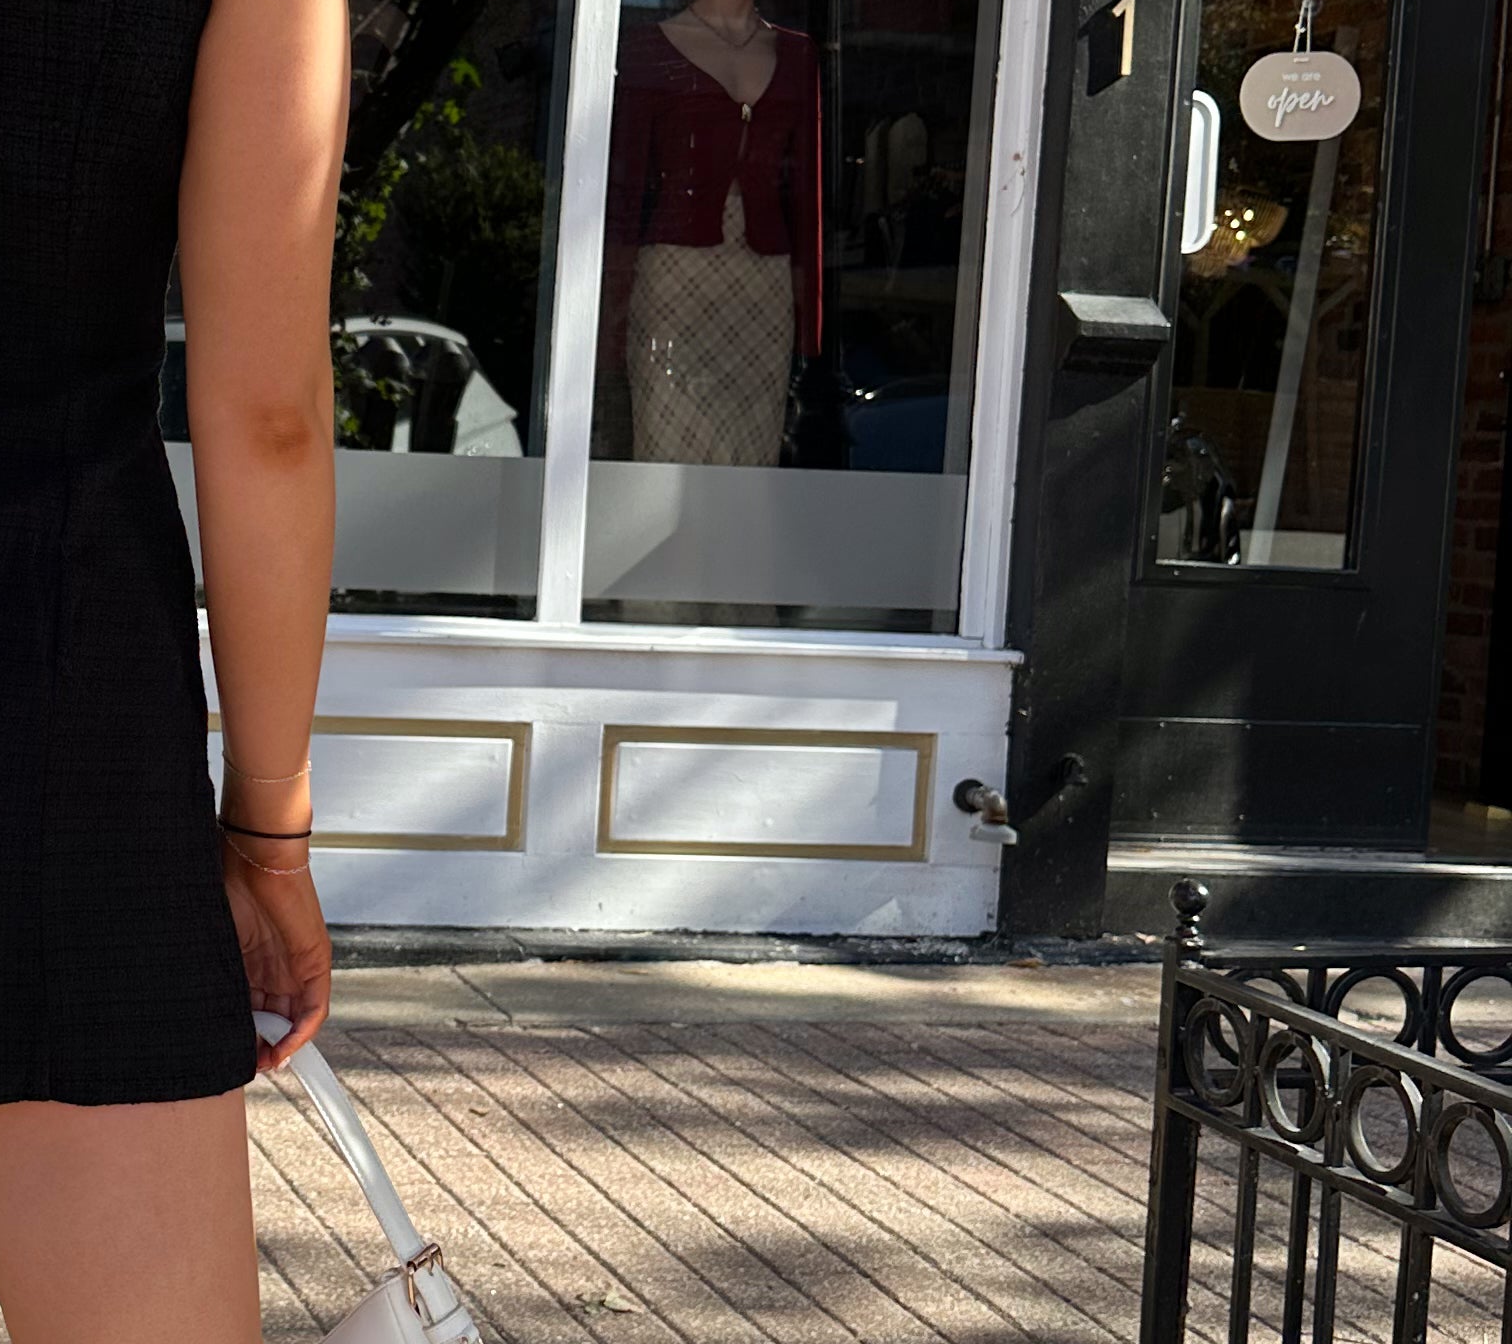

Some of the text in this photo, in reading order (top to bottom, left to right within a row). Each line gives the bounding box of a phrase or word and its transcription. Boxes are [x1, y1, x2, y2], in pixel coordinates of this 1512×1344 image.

[1282, 72, 1321, 81] we are
[1267, 87, 1335, 128] open
